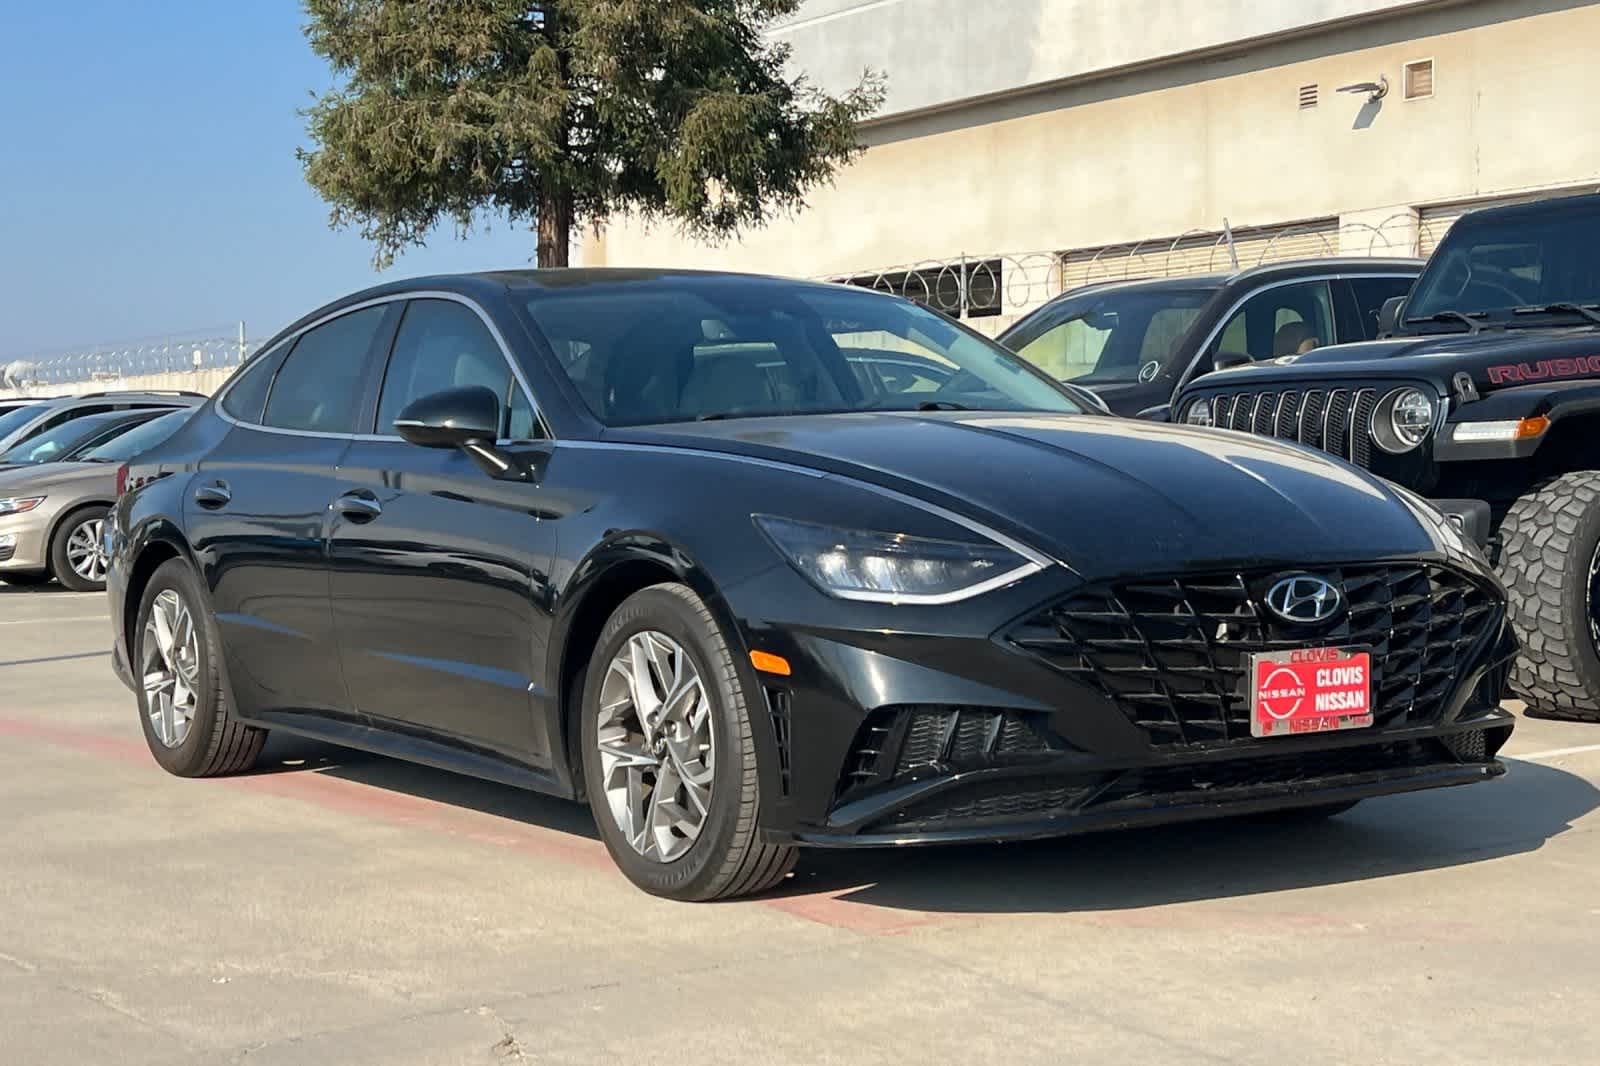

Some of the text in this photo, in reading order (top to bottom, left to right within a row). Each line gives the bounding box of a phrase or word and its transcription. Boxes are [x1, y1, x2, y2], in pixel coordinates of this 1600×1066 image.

[1290, 648, 1338, 663] CLOVIS
[1316, 666, 1363, 687] CLOVIS
[1258, 688, 1306, 700] NISSAN
[1315, 690, 1364, 712] NISSAN
